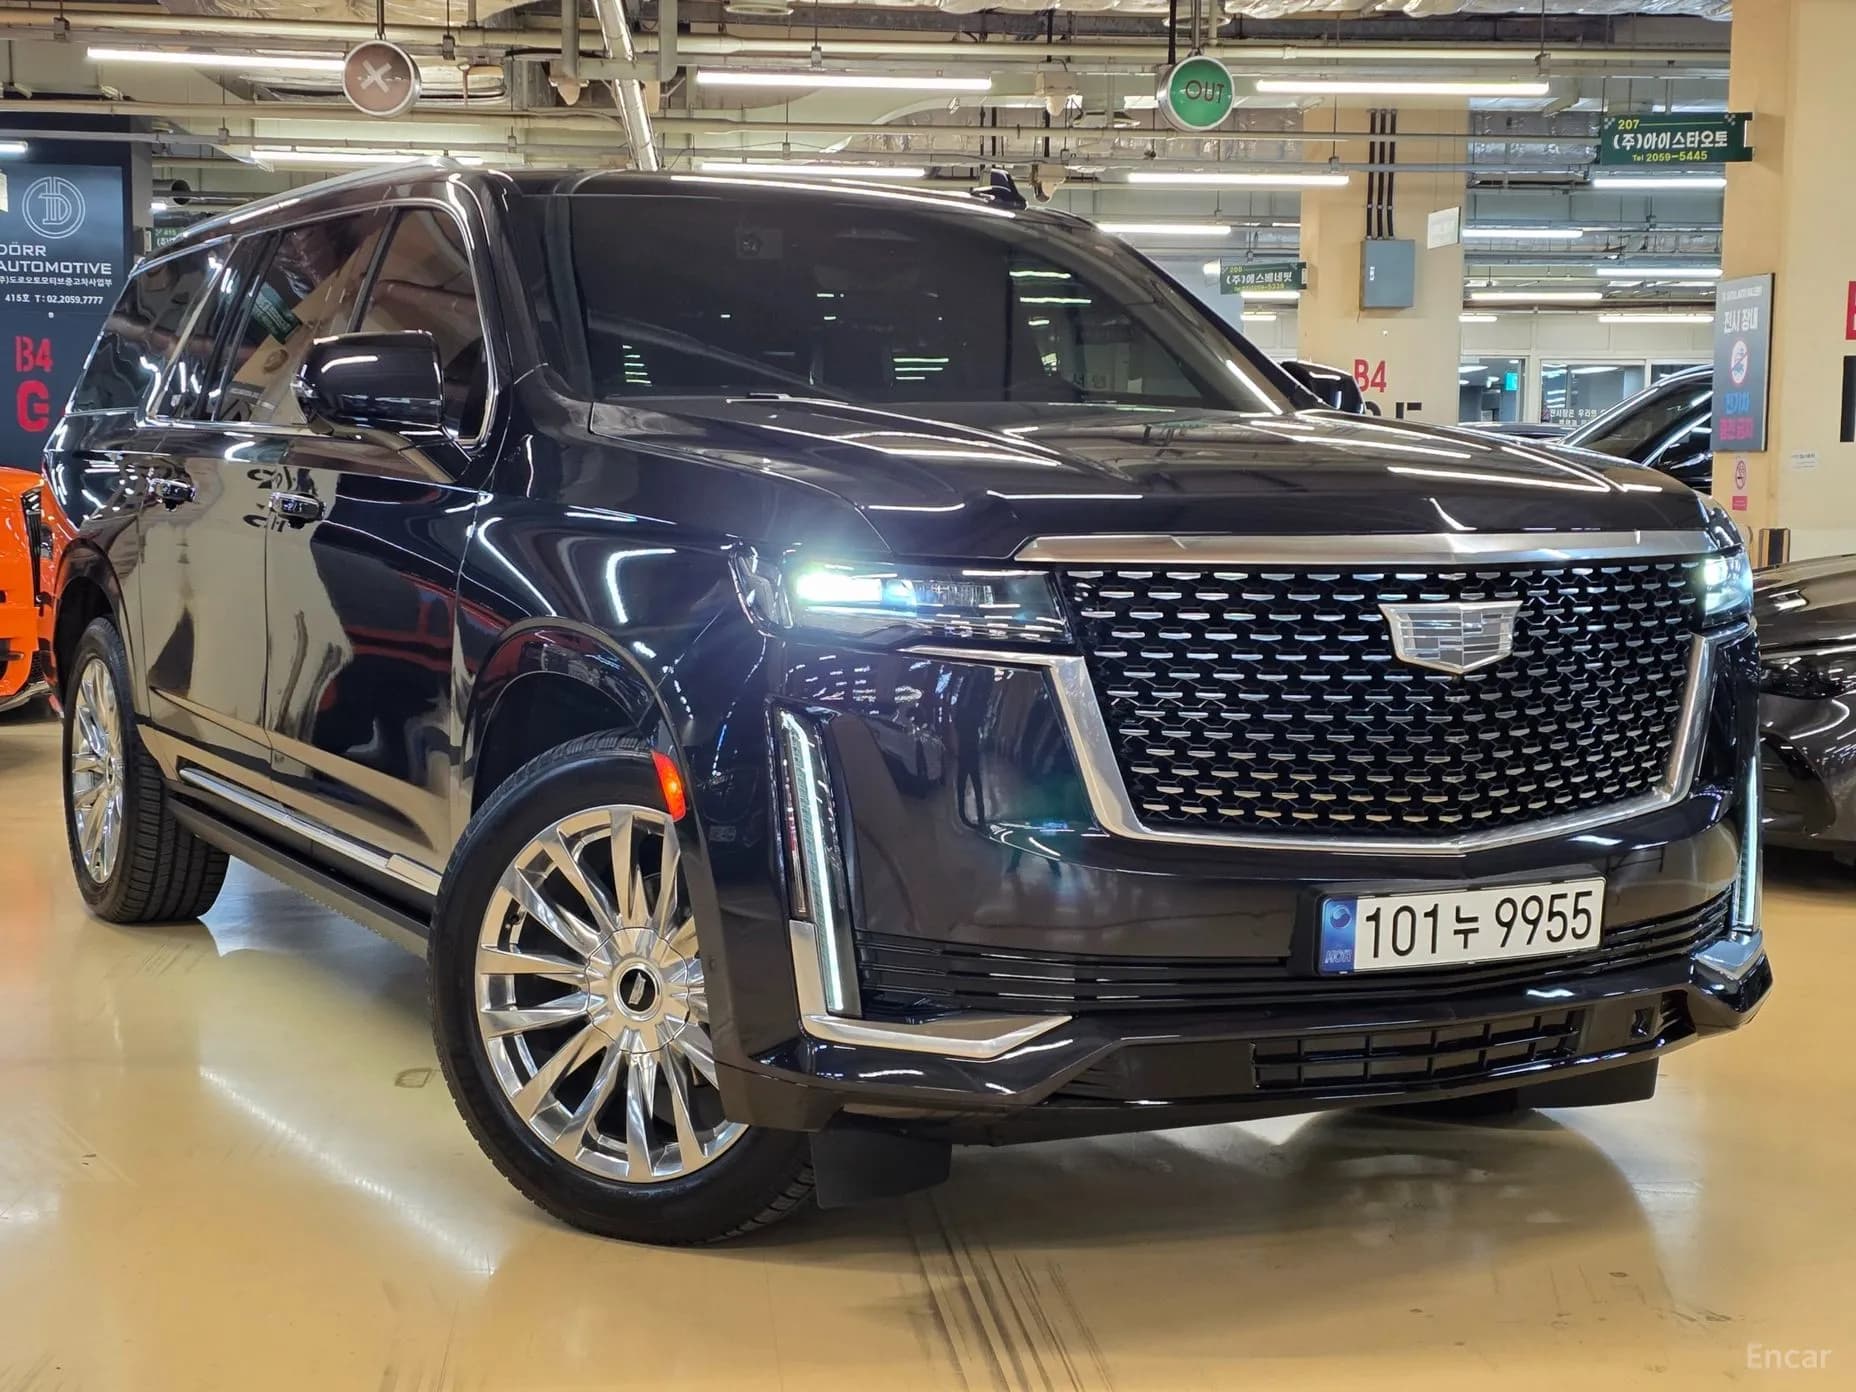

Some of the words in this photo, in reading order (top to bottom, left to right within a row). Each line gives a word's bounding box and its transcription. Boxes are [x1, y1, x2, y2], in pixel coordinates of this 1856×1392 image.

[1186, 80, 1224, 103] OUT
[1618, 119, 1640, 130] 207
[1613, 131, 1728, 151] (주)아이스타오토
[1646, 150, 1708, 162] 2059-5445
[0, 260, 112, 275] AUTOMOTIVE
[15, 335, 53, 372] B4
[1354, 359, 1387, 393] B4
[1366, 903, 1479, 958] 101누
[1495, 891, 1593, 948] 9955
